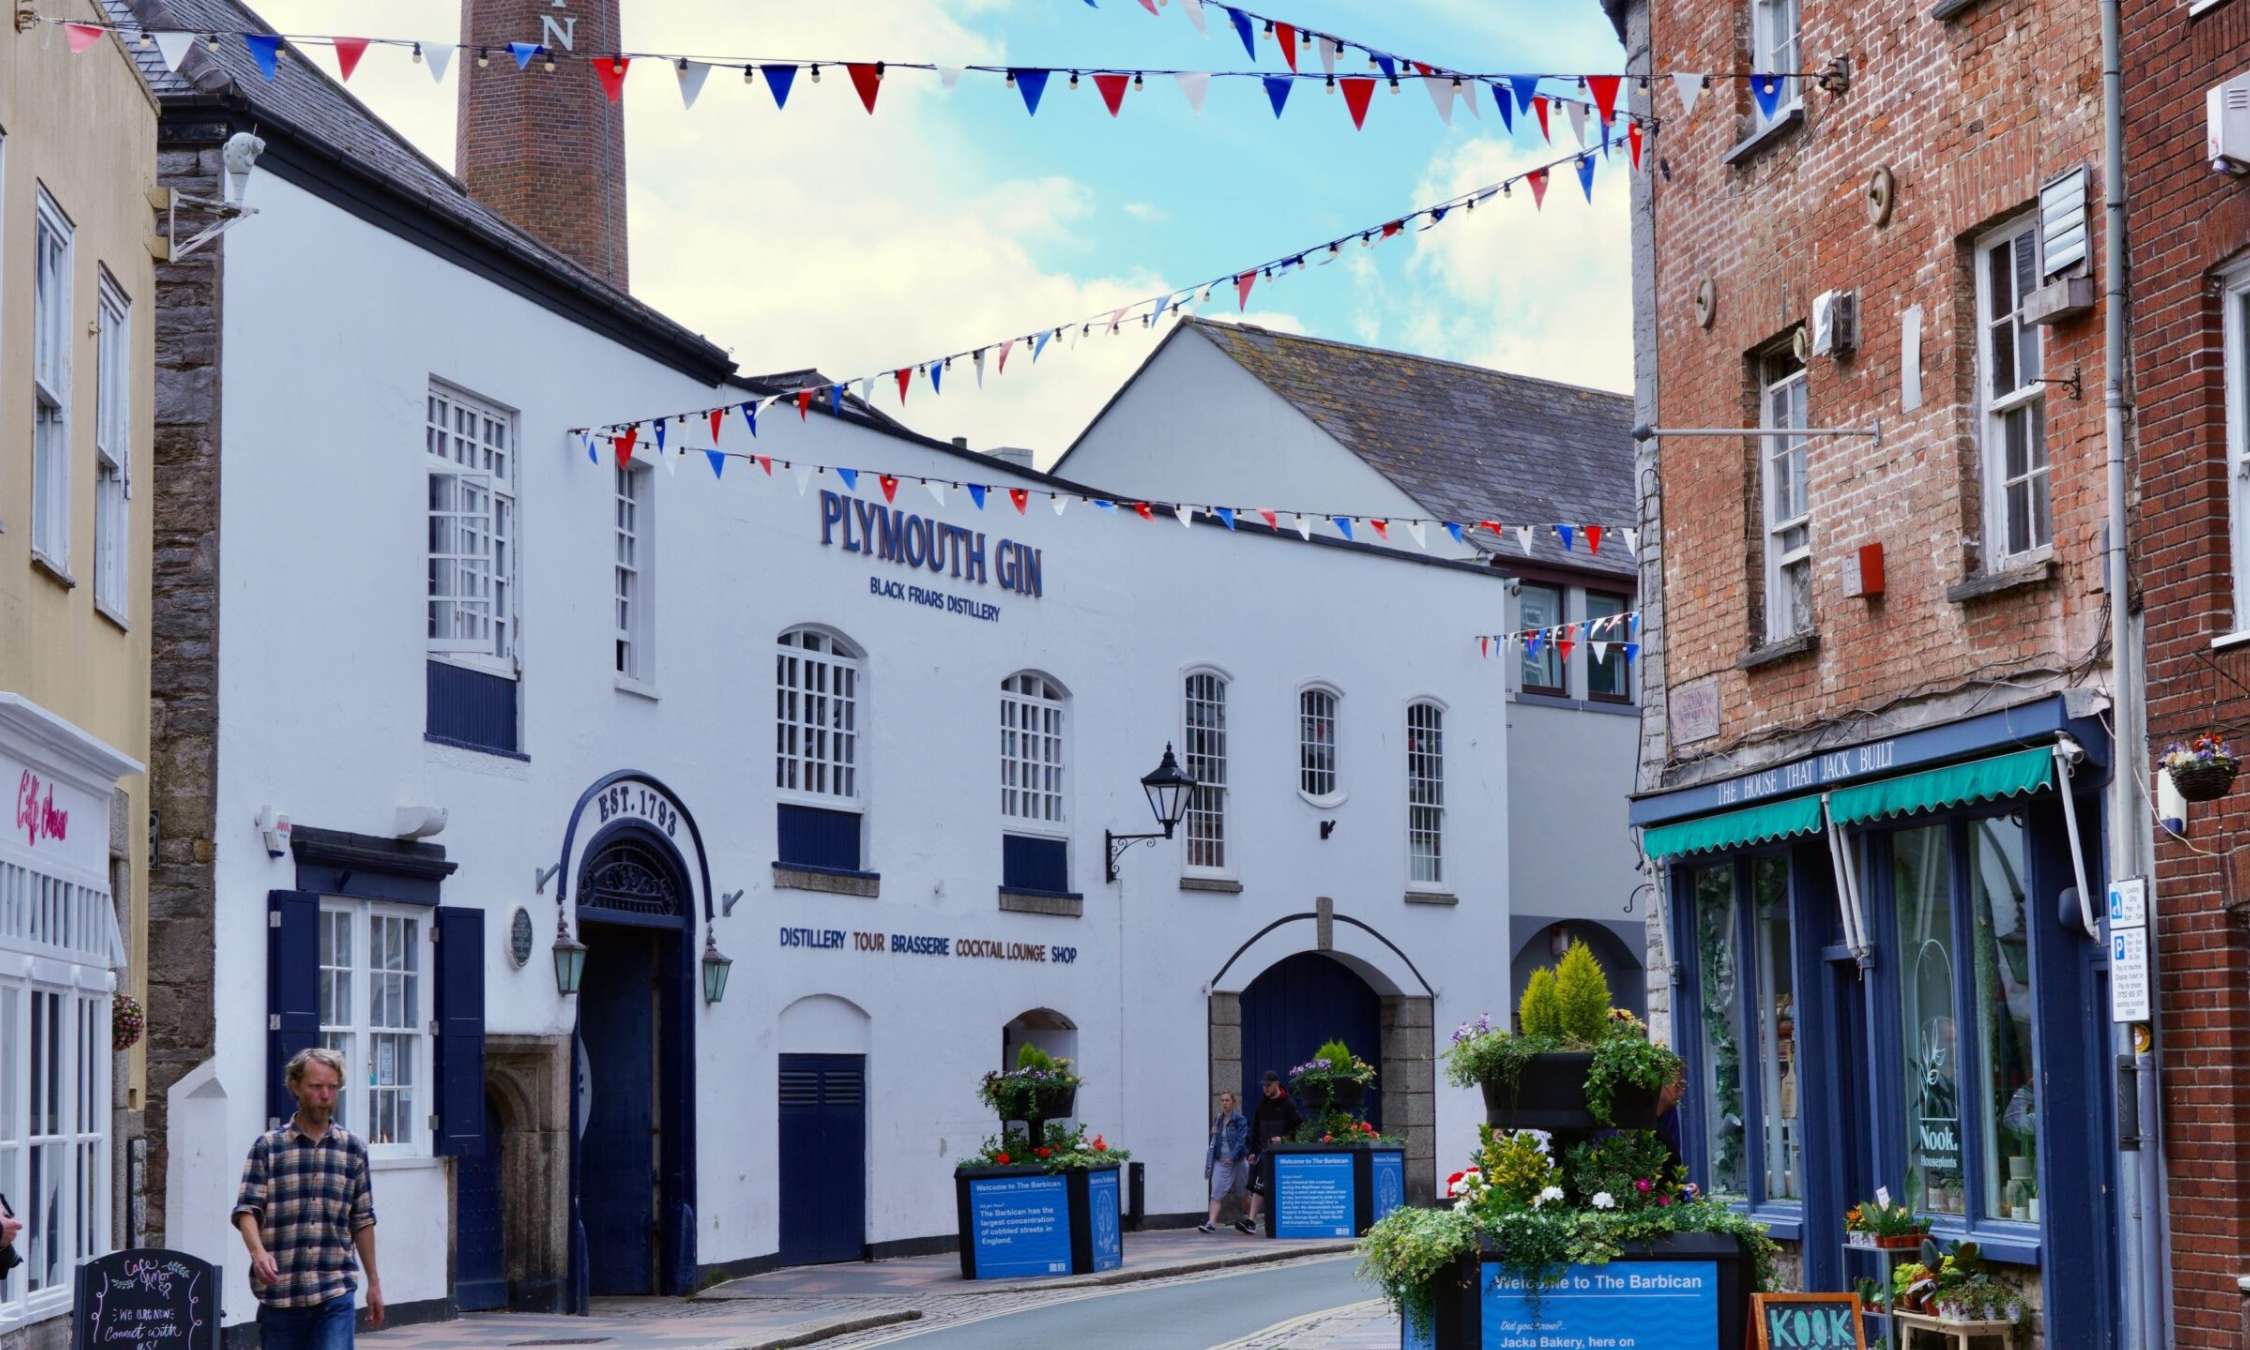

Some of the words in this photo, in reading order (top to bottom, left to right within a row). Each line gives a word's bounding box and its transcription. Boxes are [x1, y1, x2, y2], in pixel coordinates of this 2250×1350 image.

[819, 489, 987, 585] PLYMOUTH
[995, 538, 1042, 599] GIN
[870, 576, 905, 601] BLACK
[908, 585, 944, 610] FRIARS
[947, 594, 1000, 623] DISTILLERY
[1717, 783, 1737, 805] THE
[1744, 770, 1777, 800] HOUSE
[1785, 760, 1814, 789] THAT
[1822, 752, 1851, 780] JACK
[1860, 741, 1894, 772] BUILT
[640, 790, 677, 837] 1793
[780, 926, 847, 950] DISTILLERY
[853, 931, 885, 952] TOUR
[891, 934, 950, 956] BRASSERIE
[956, 938, 1005, 960] COCKTAIL
[1007, 942, 1046, 963] LOUNGE
[1052, 945, 1077, 965] SHOP
[1920, 1125, 1958, 1151] Nook.
[994, 1208, 1026, 1217] Barbican
[1574, 1274, 1590, 1289] to
[1595, 1274, 1625, 1289] The
[1629, 1274, 1702, 1289] Barbican
[148, 1323, 182, 1338] with
[1500, 1320, 1517, 1331] Did
[1770, 1309, 1857, 1347] KOOK
[1500, 1336, 1537, 1349] Jacka
[1540, 1336, 1586, 1350] Bakery,
[1588, 1336, 1616, 1348] here
[1618, 1338, 1635, 1348] on
